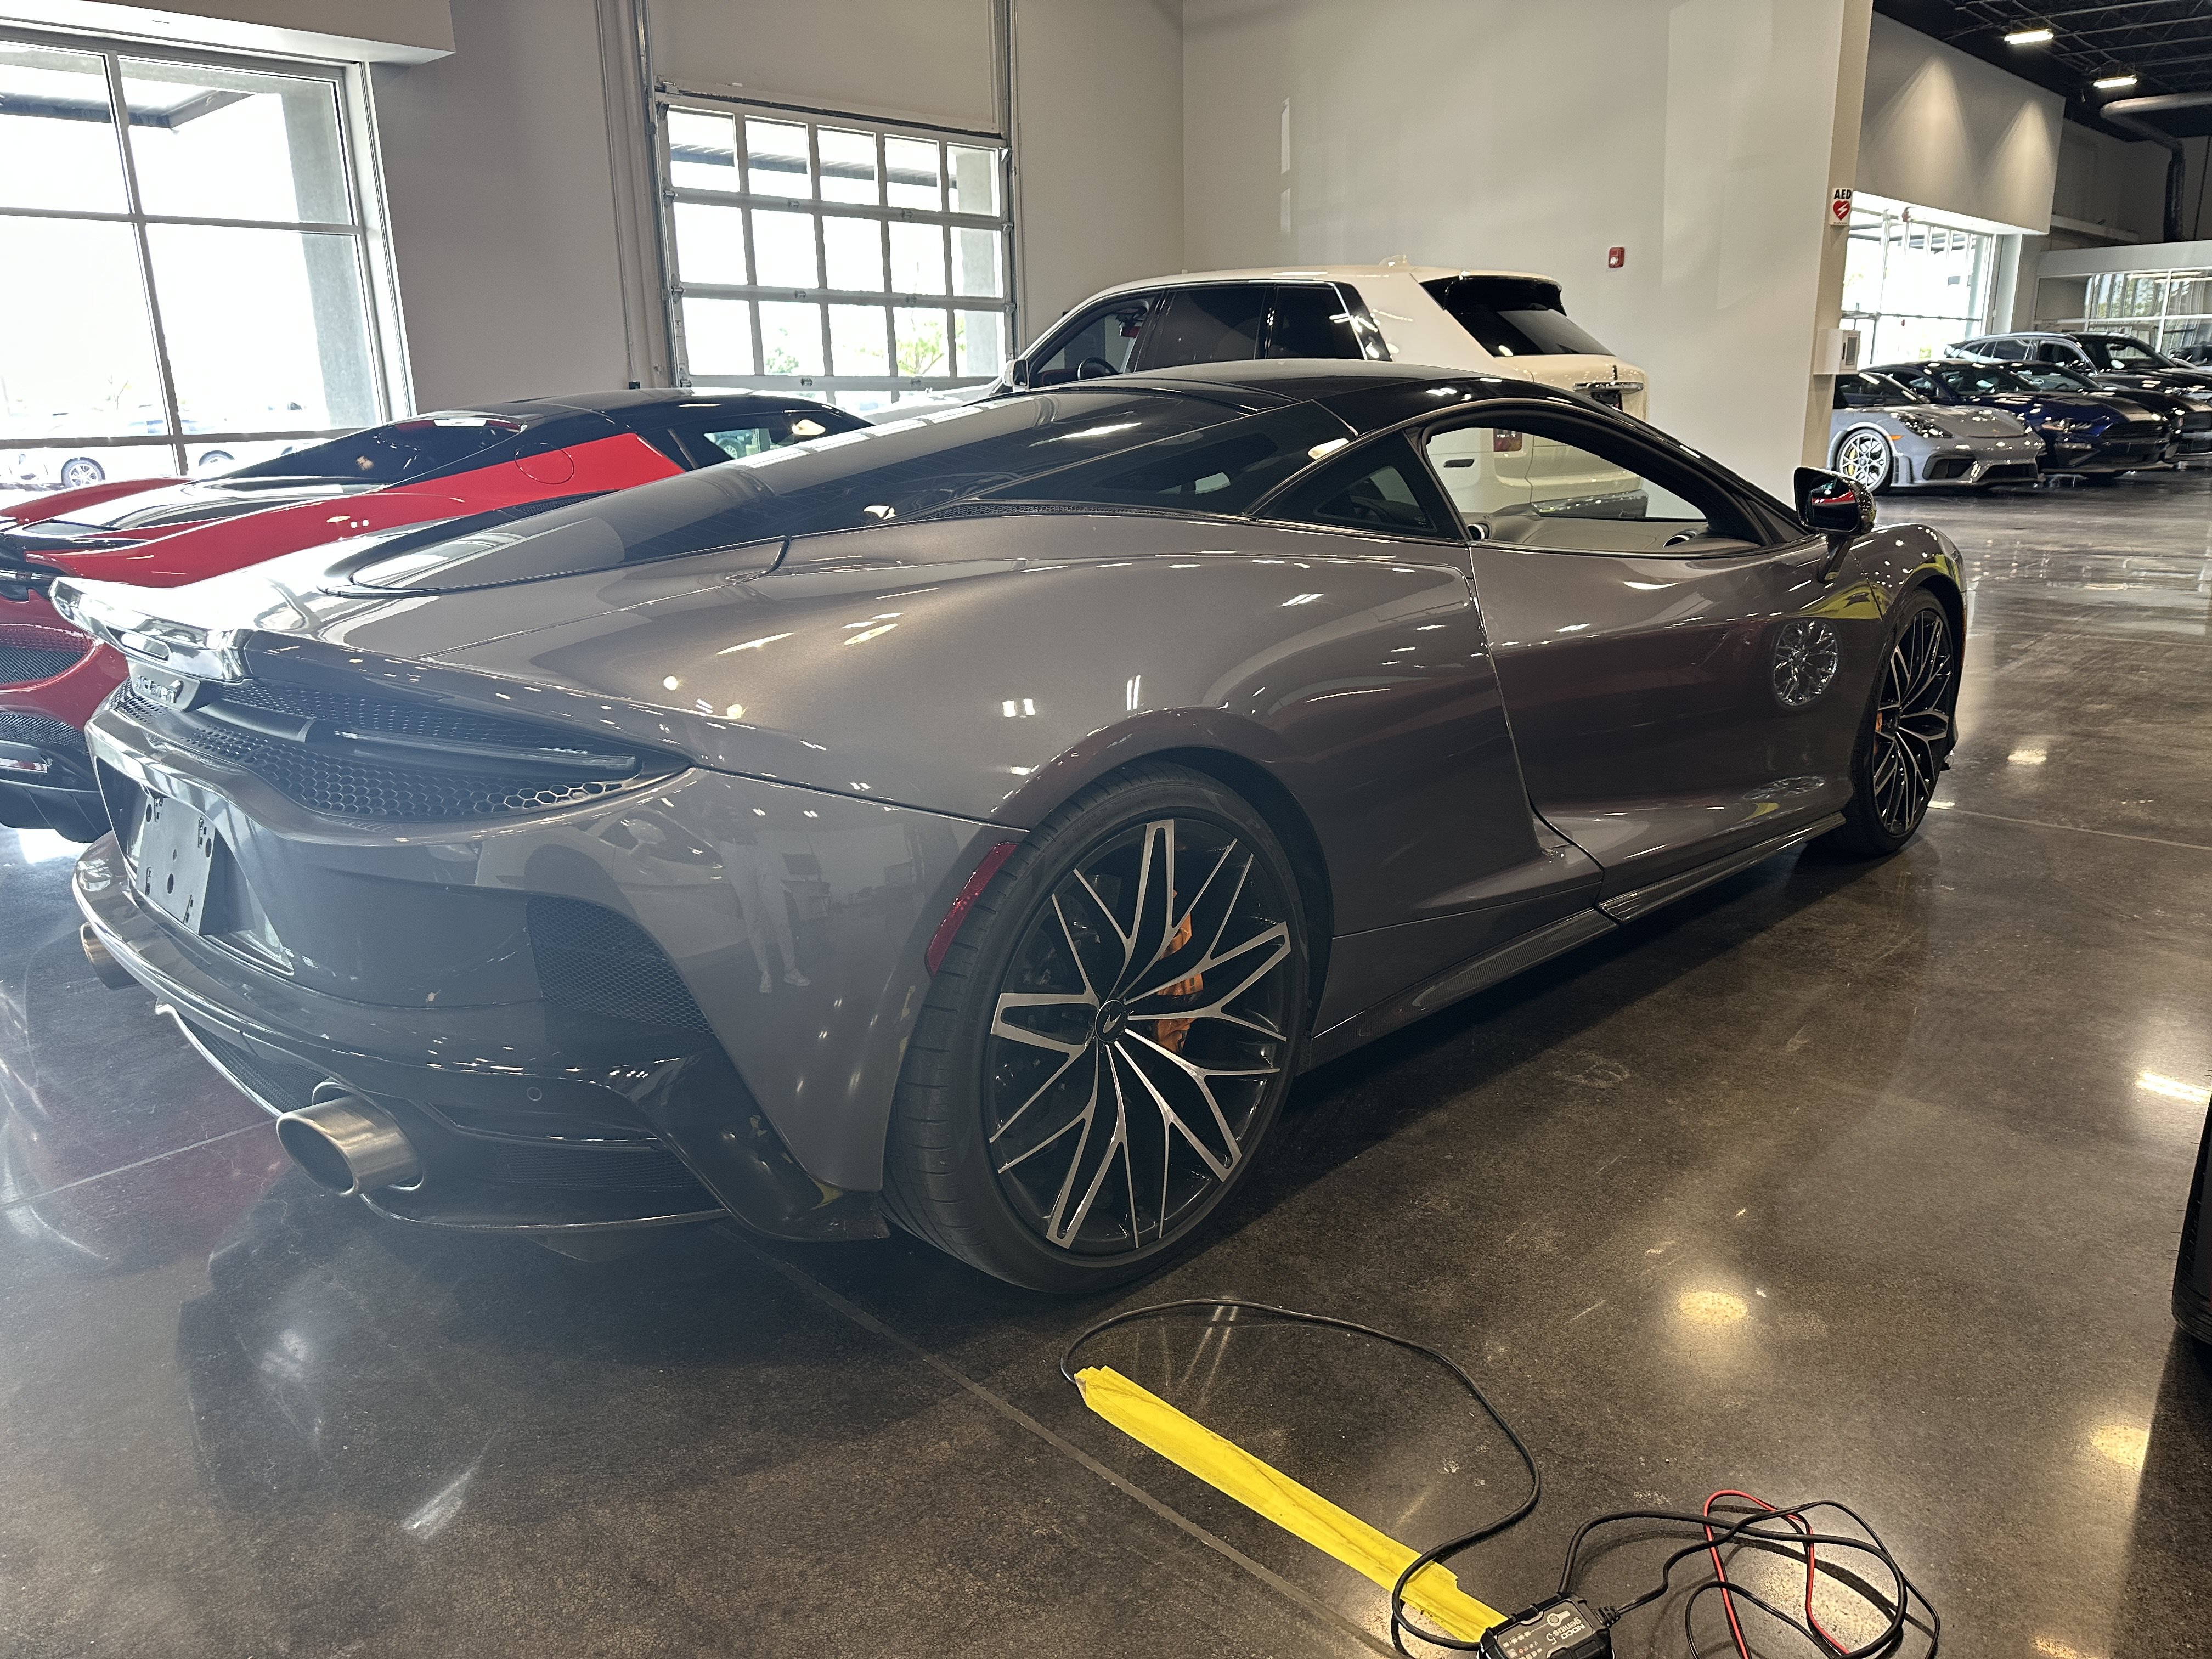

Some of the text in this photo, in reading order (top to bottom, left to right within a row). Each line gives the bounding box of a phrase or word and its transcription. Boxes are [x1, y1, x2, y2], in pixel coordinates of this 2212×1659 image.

[1834, 189, 1852, 199] AED
[1546, 1617, 1582, 1645] genius 5
[1561, 1624, 1585, 1639] NOCO
